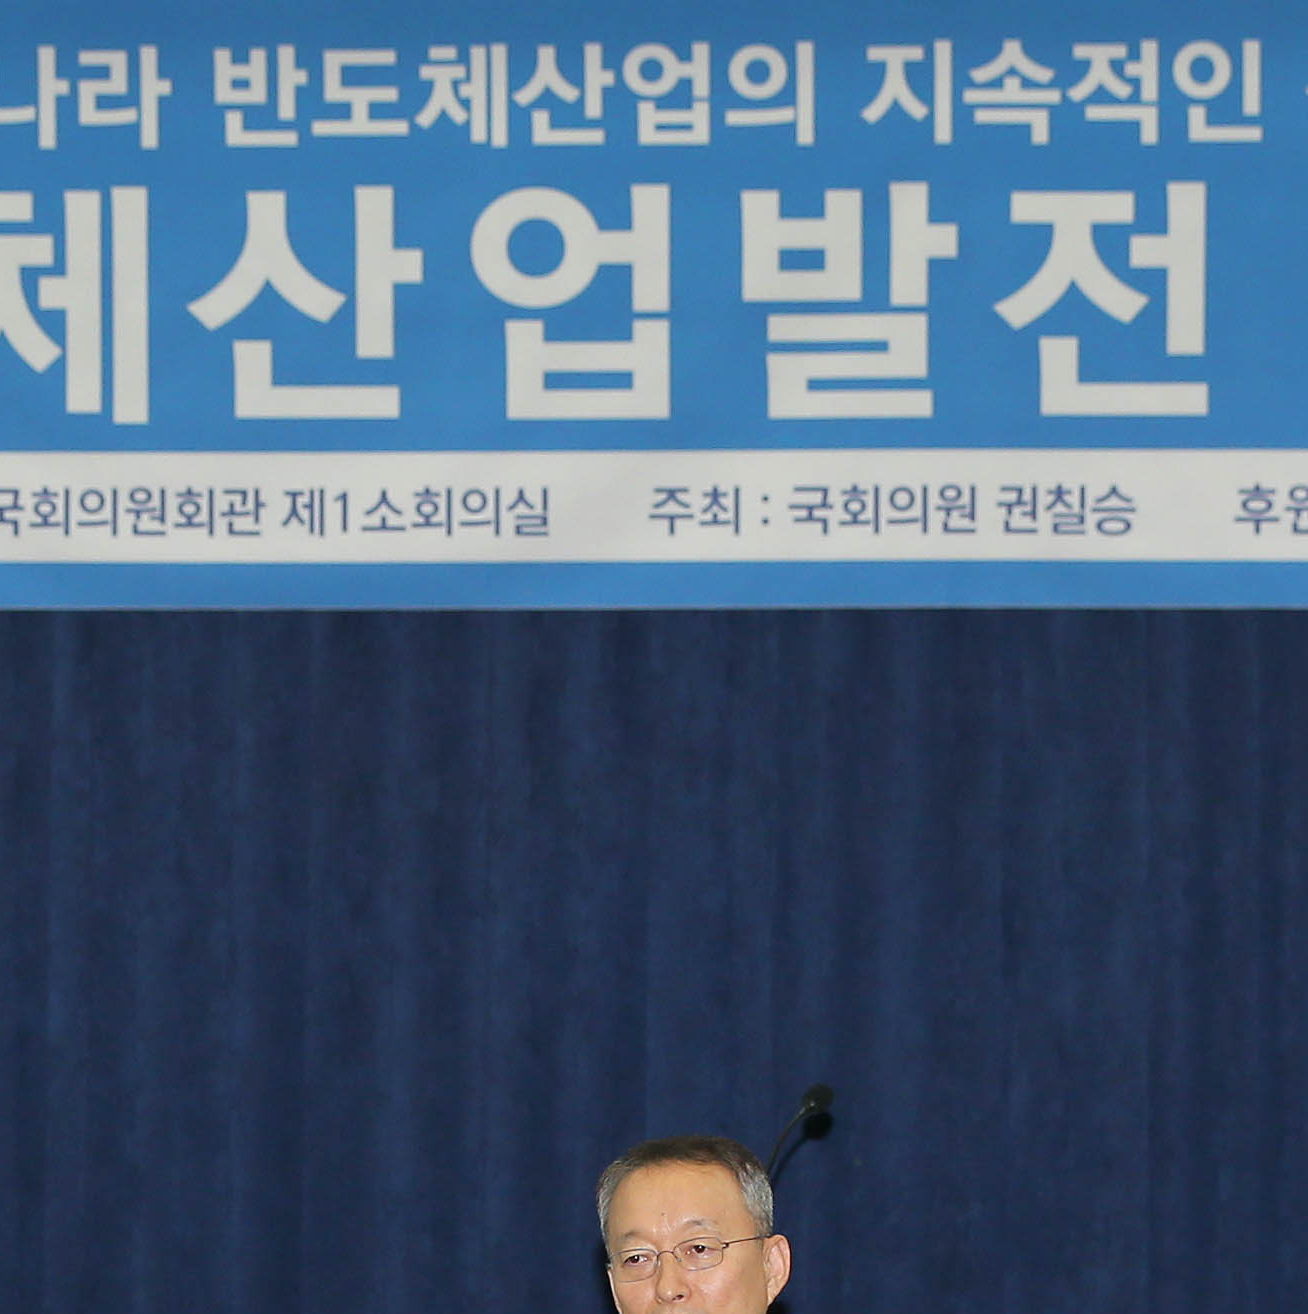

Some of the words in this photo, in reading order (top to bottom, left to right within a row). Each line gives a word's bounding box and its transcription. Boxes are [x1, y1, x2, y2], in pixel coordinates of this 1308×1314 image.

[214, 41, 815, 148] 반도체산업의
[862, 39, 1263, 145] 지속적인
[282, 487, 549, 537] 제1소회의실
[788, 484, 976, 535] 국회의원
[997, 484, 1136, 536] 권칠승
